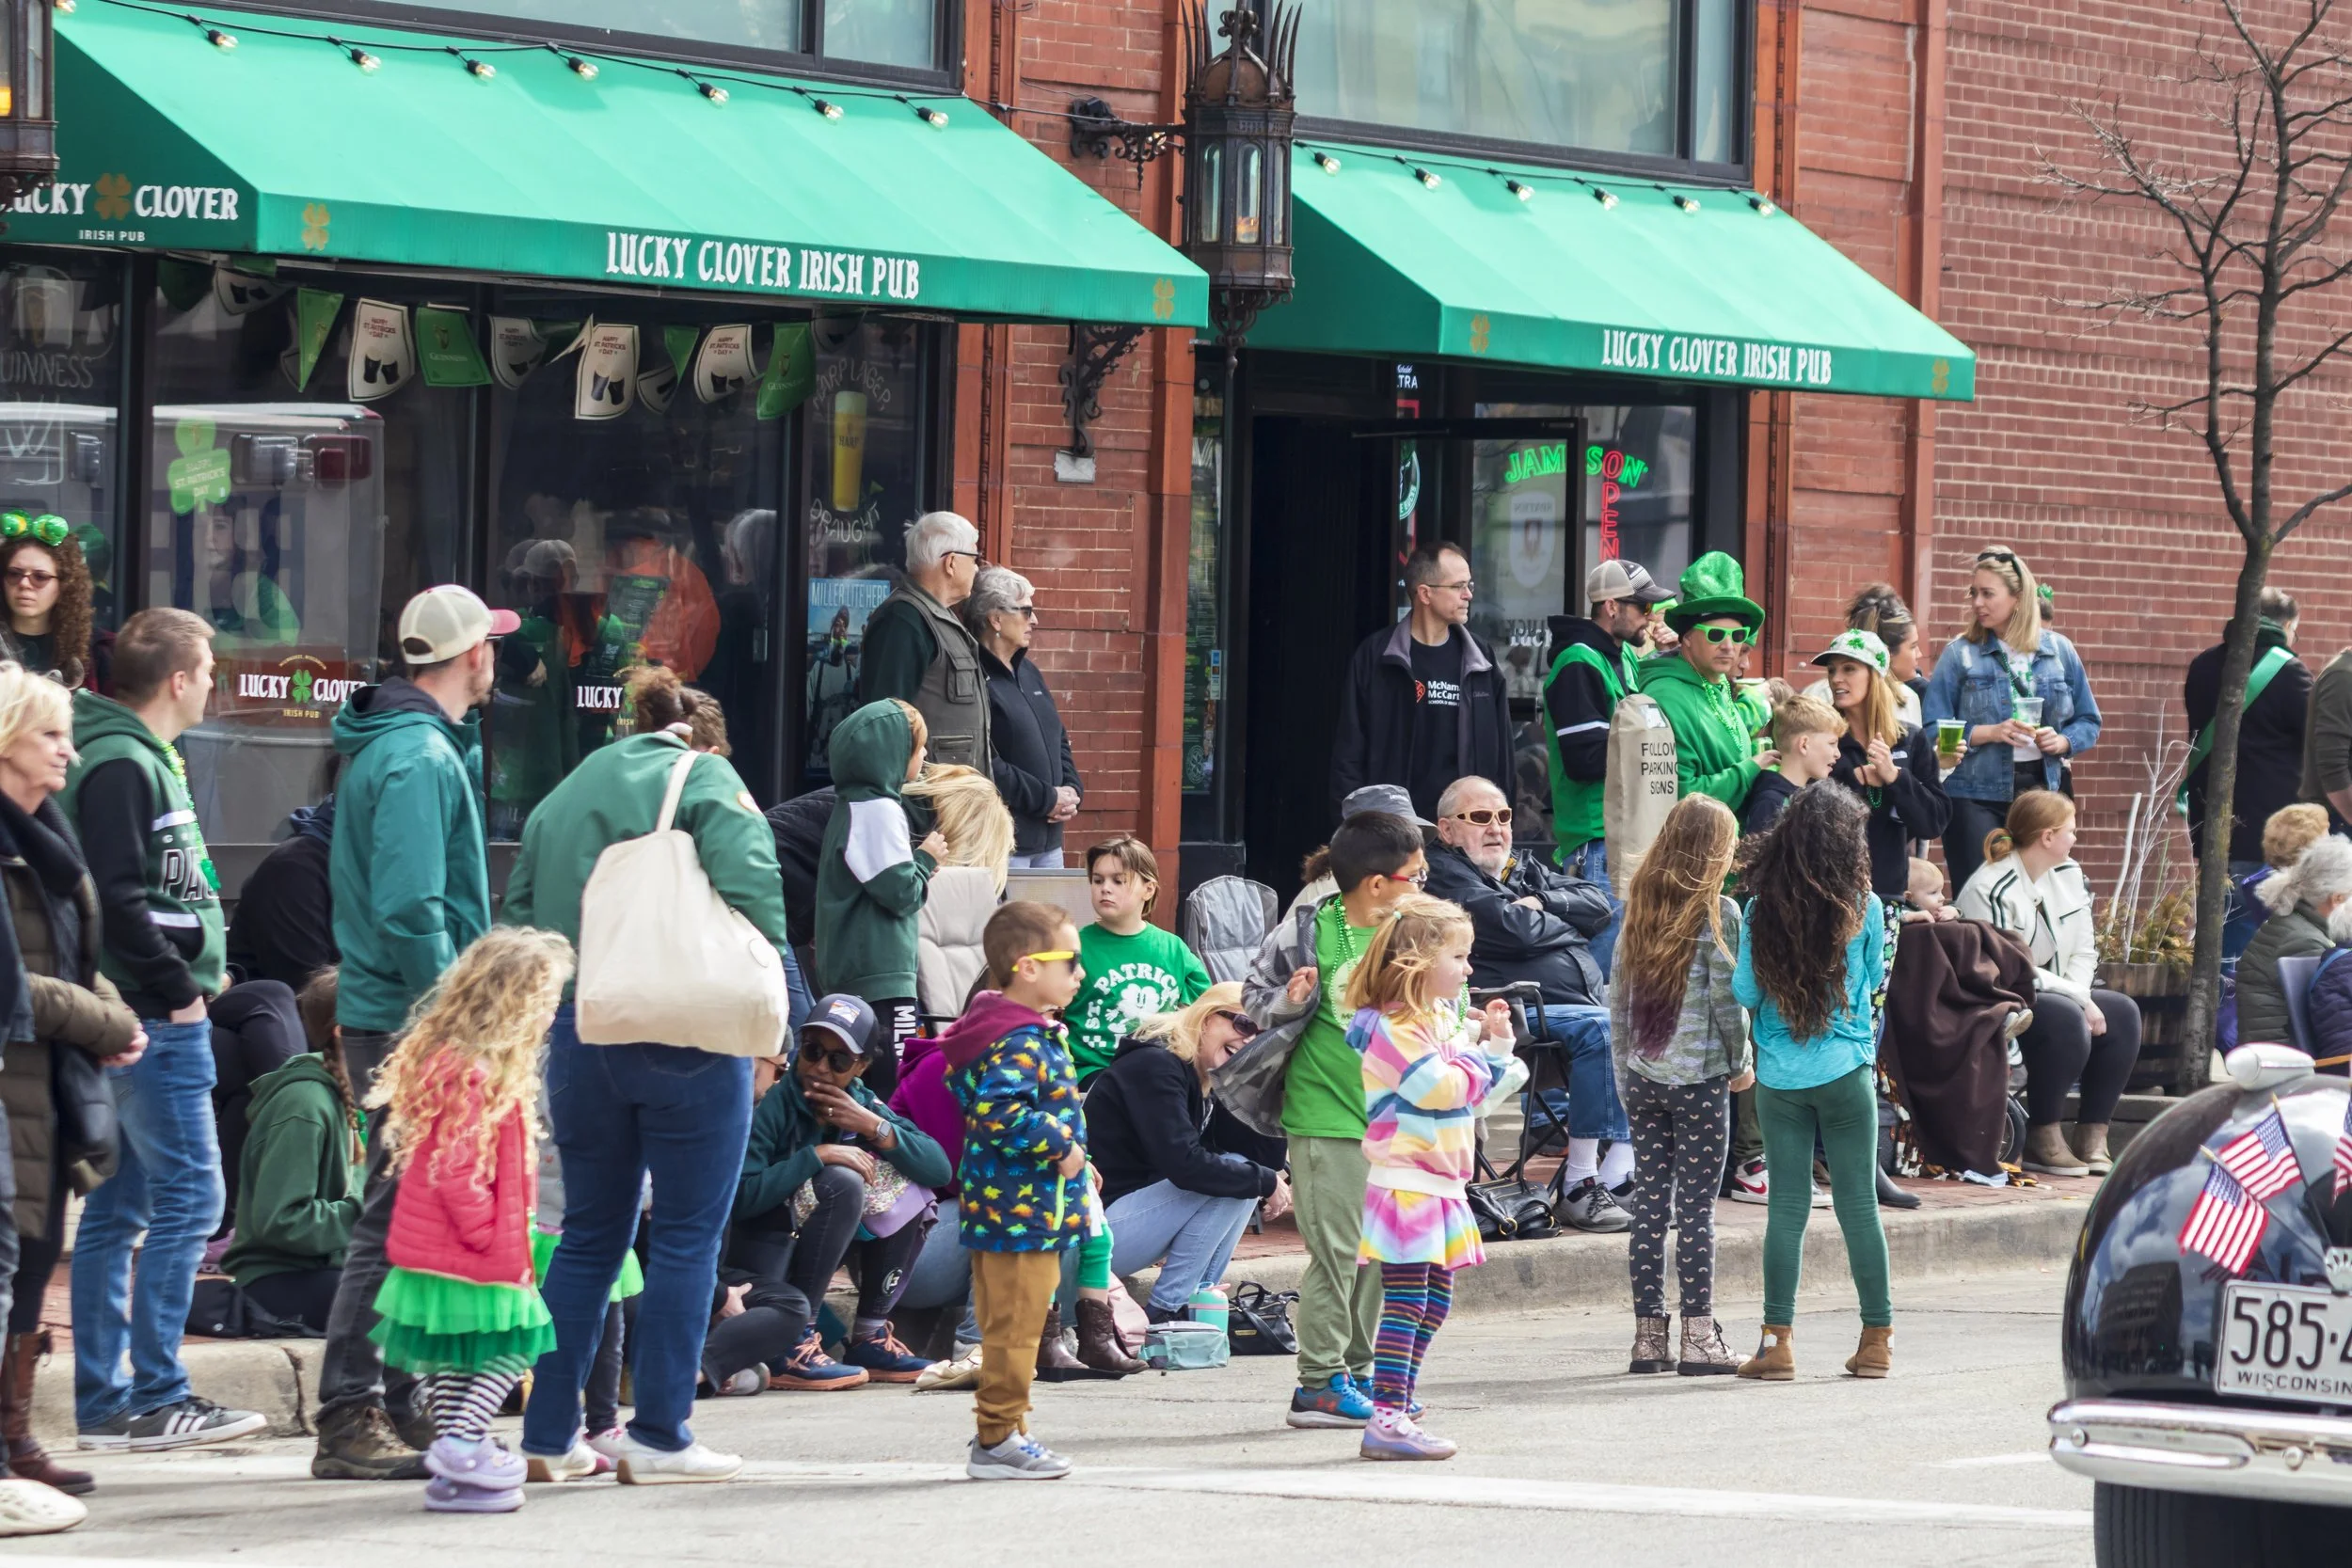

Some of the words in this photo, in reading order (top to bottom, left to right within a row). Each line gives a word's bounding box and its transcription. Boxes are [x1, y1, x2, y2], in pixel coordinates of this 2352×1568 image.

[135, 185, 239, 221] CLOVER
[79, 230, 115, 241] IRISH
[119, 230, 146, 242] PUB
[607, 232, 691, 278] LUCKY
[698, 240, 791, 288] CLOVER
[799, 249, 865, 295] IRISH
[871, 256, 919, 300] PUB
[1602, 329, 1664, 370] LUCKY
[1669, 337, 1738, 376] CLOVER
[1742, 342, 1791, 382] IRISH
[1795, 348, 1832, 385] PUB
[1397, 374, 1418, 388] TRA
[1505, 443, 1645, 488] JAMSN
[810, 498, 881, 543] DRAUGHT
[1600, 451, 1625, 562] OPEN
[811, 581, 845, 606] MILLER
[847, 583, 865, 607] LITE
[239, 673, 291, 699] LUCKY
[313, 678, 367, 703] CLOV
[577, 686, 623, 708] LUCKY
[1428, 680, 1460, 692] McNam
[283, 709, 303, 718] IRISH
[304, 710, 320, 719] PUB
[2237, 1370, 2352, 1394] WISCONSIN
